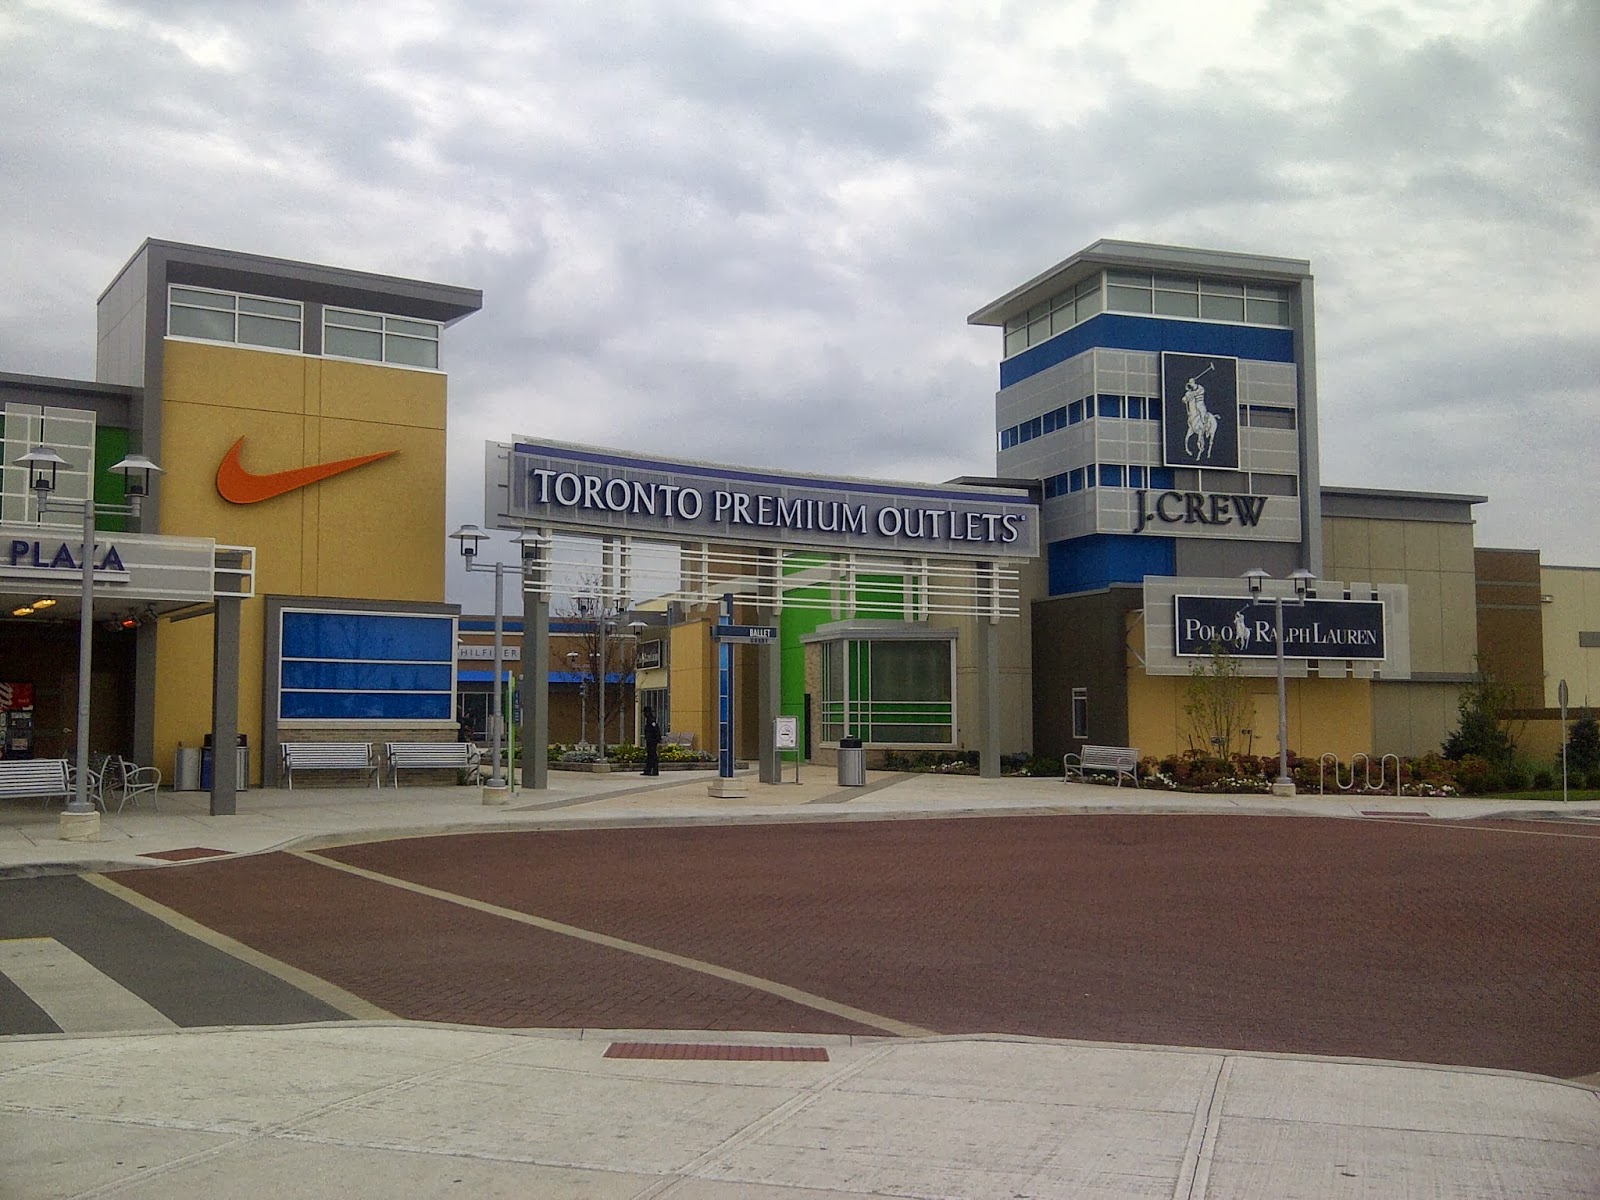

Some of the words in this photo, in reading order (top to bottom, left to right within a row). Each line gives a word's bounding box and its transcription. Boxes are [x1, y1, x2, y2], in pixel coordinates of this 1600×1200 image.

[533, 468, 703, 520] TORONTO
[714, 491, 867, 534] PREMIUM
[1133, 490, 1268, 533] J.CREW
[750, 628, 771, 637] BALLET
[1185, 618, 1233, 641] POLO
[1313, 622, 1377, 645] LAUREN
[460, 648, 517, 658] HILFIER
